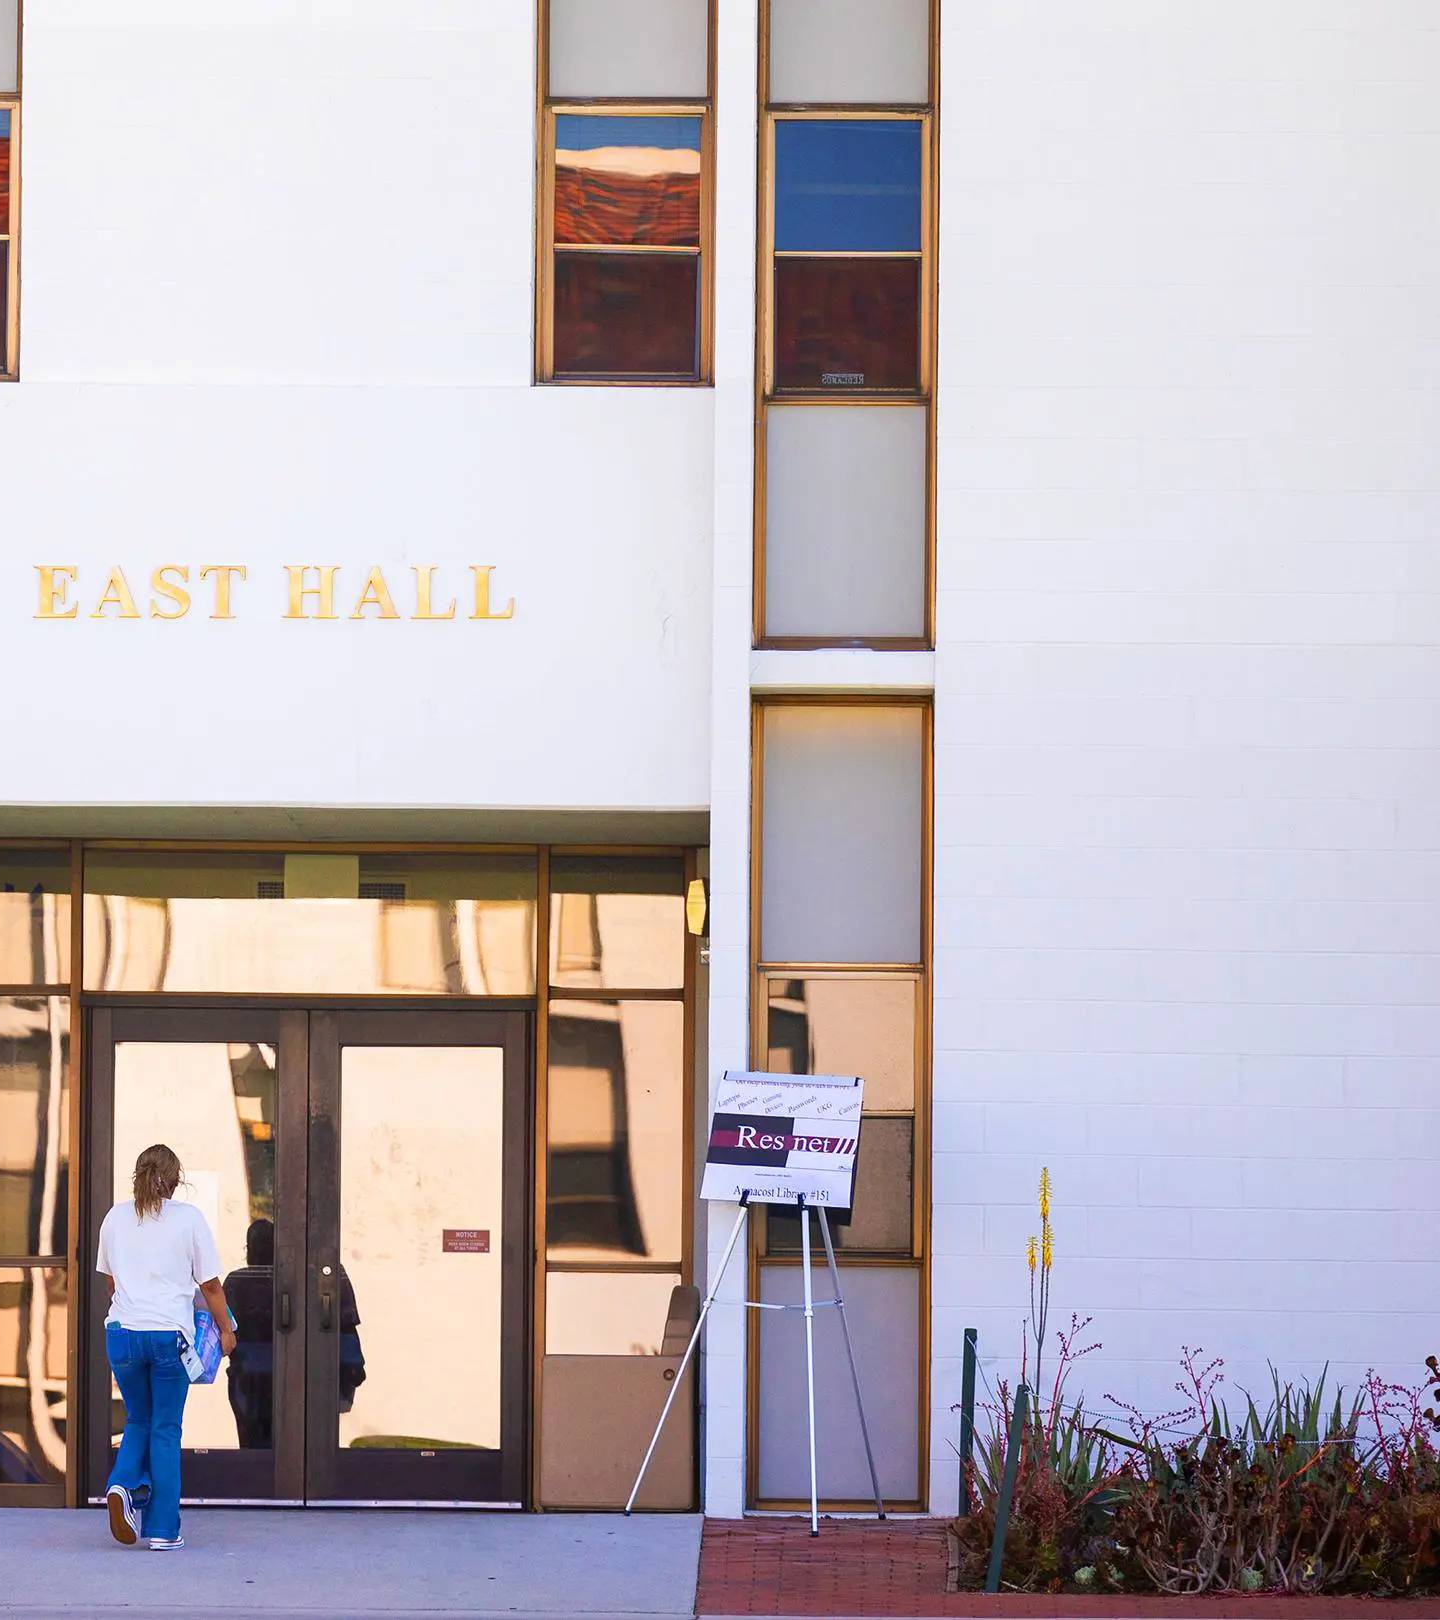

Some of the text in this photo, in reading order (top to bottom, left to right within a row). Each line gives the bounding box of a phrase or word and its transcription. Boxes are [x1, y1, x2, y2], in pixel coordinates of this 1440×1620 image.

[32, 564, 516, 620] EAST HALL
[737, 1096, 759, 1111] Phones
[787, 1095, 817, 1114] Passwords
[816, 1102, 833, 1115] UKG
[838, 1101, 860, 1116] Canvas
[734, 1125, 831, 1153] Res net
[810, 1190, 830, 1202] #151
